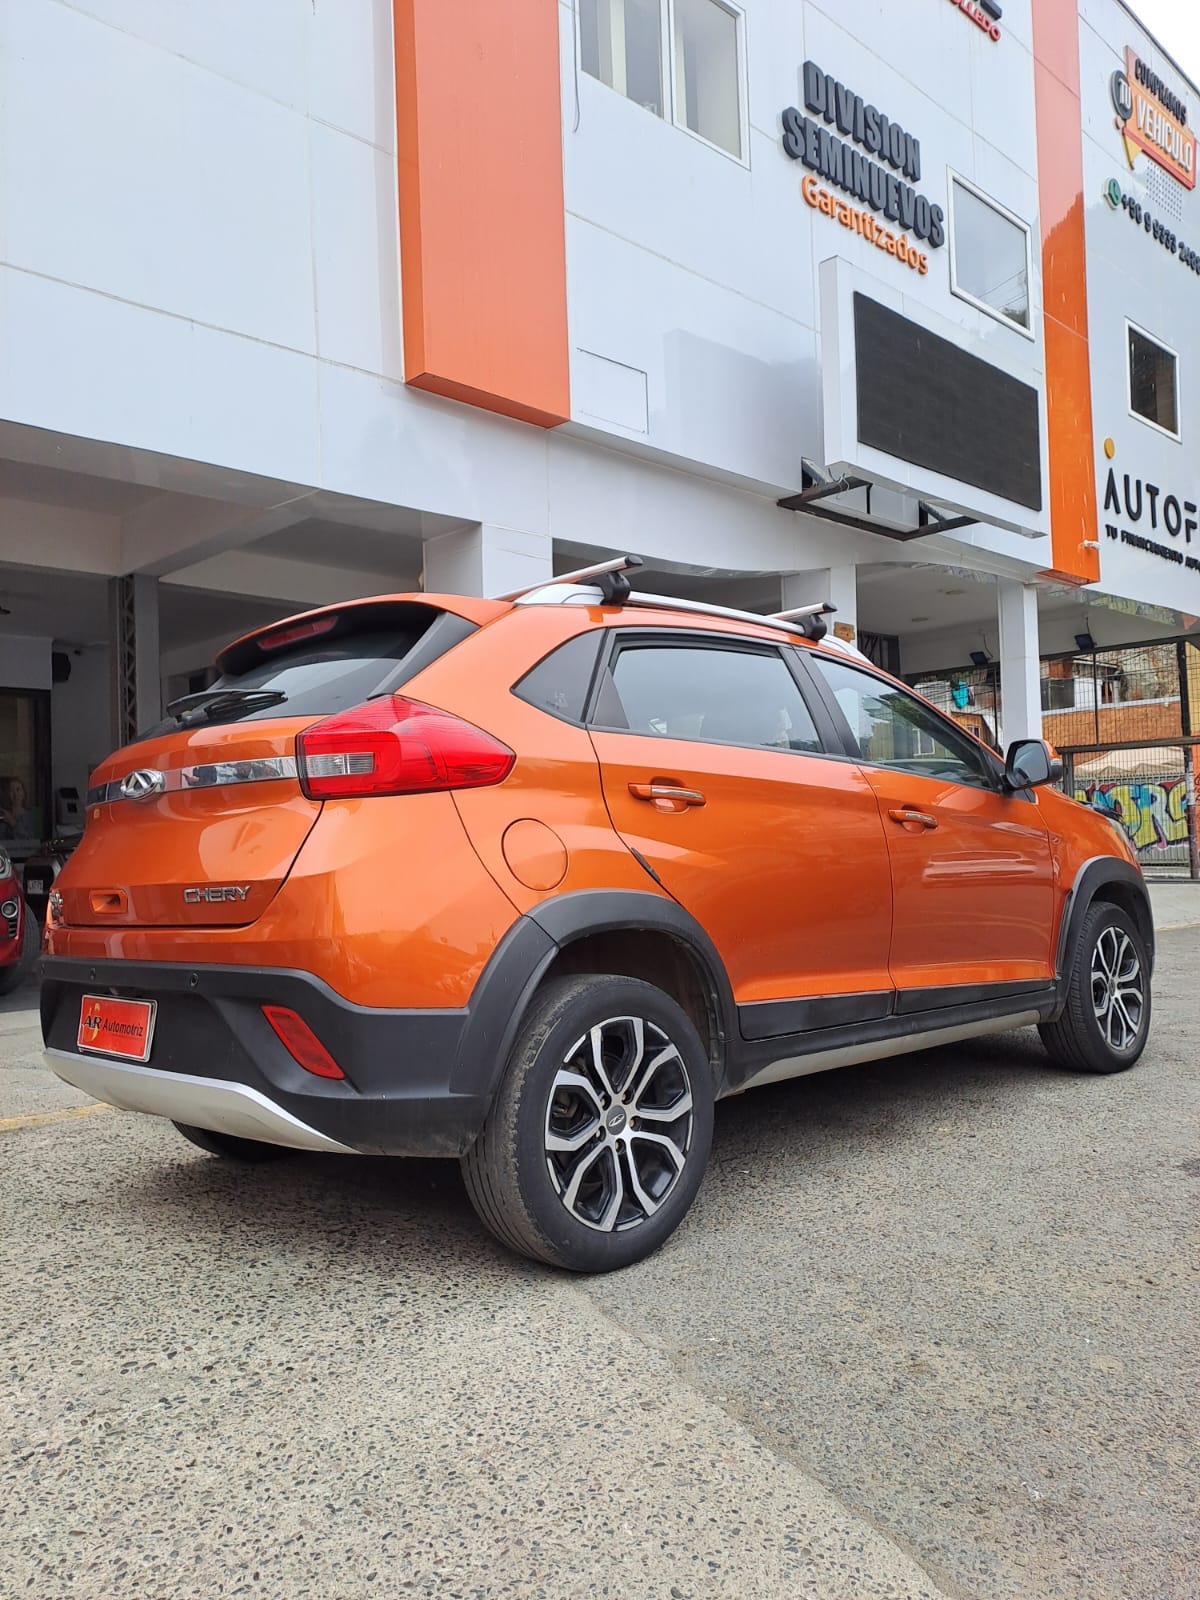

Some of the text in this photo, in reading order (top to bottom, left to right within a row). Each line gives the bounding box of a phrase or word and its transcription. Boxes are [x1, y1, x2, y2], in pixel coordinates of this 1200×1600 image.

[950, 0, 1001, 42] LLEDO
[1118, 77, 1132, 110] TU
[1134, 57, 1187, 126] COMPRAMOS
[803, 60, 921, 182] DIVISION
[1136, 95, 1193, 173] VEHICULO
[782, 106, 945, 248] SEMINUEVOS
[801, 174, 929, 275] Garantizados
[1144, 211, 1151, 233] 9
[1105, 524, 1118, 540] TU
[184, 885, 251, 902] CHERY
[84, 1015, 144, 1037] AR Automotriz
